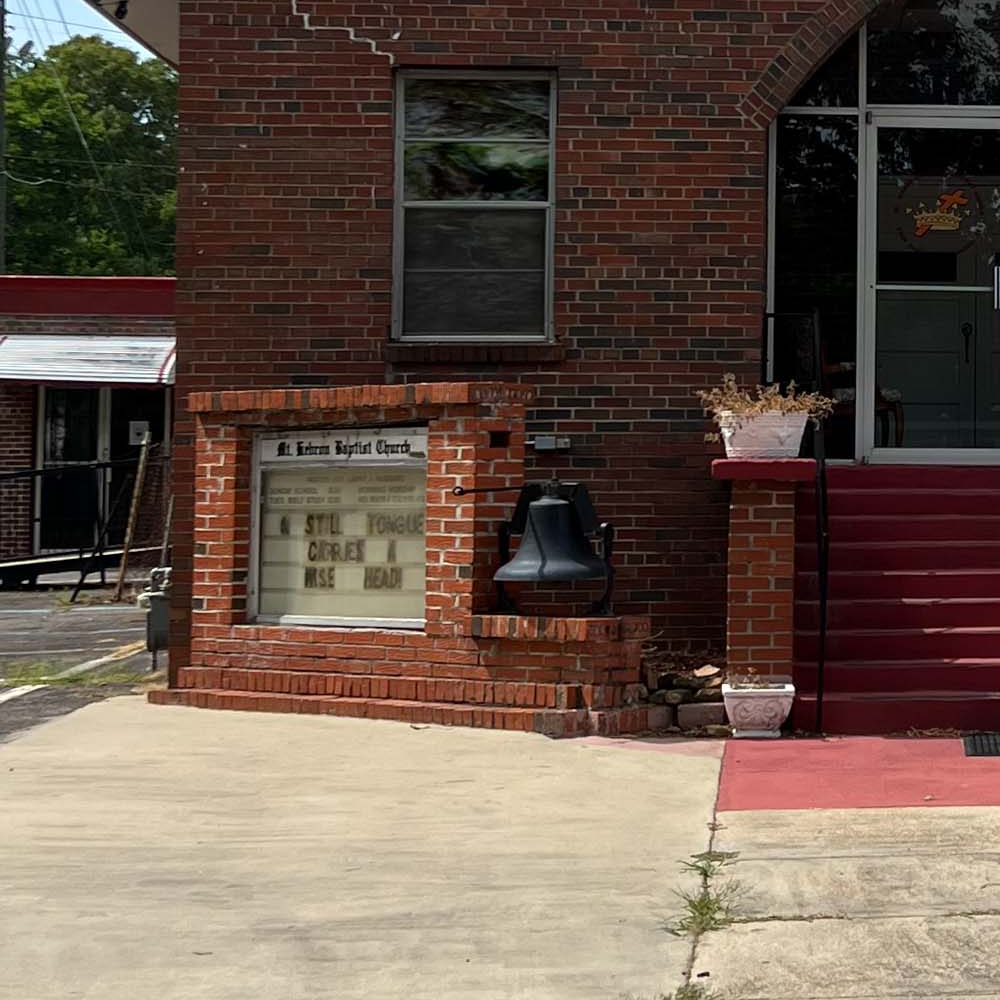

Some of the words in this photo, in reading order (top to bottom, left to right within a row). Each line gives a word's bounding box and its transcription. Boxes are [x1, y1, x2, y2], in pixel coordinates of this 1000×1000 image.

[296, 440, 330, 456] Hebron
[335, 439, 372, 458] Baptist
[376, 438, 411, 457] Church
[305, 513, 343, 535] STILL
[304, 567, 335, 589] WISE
